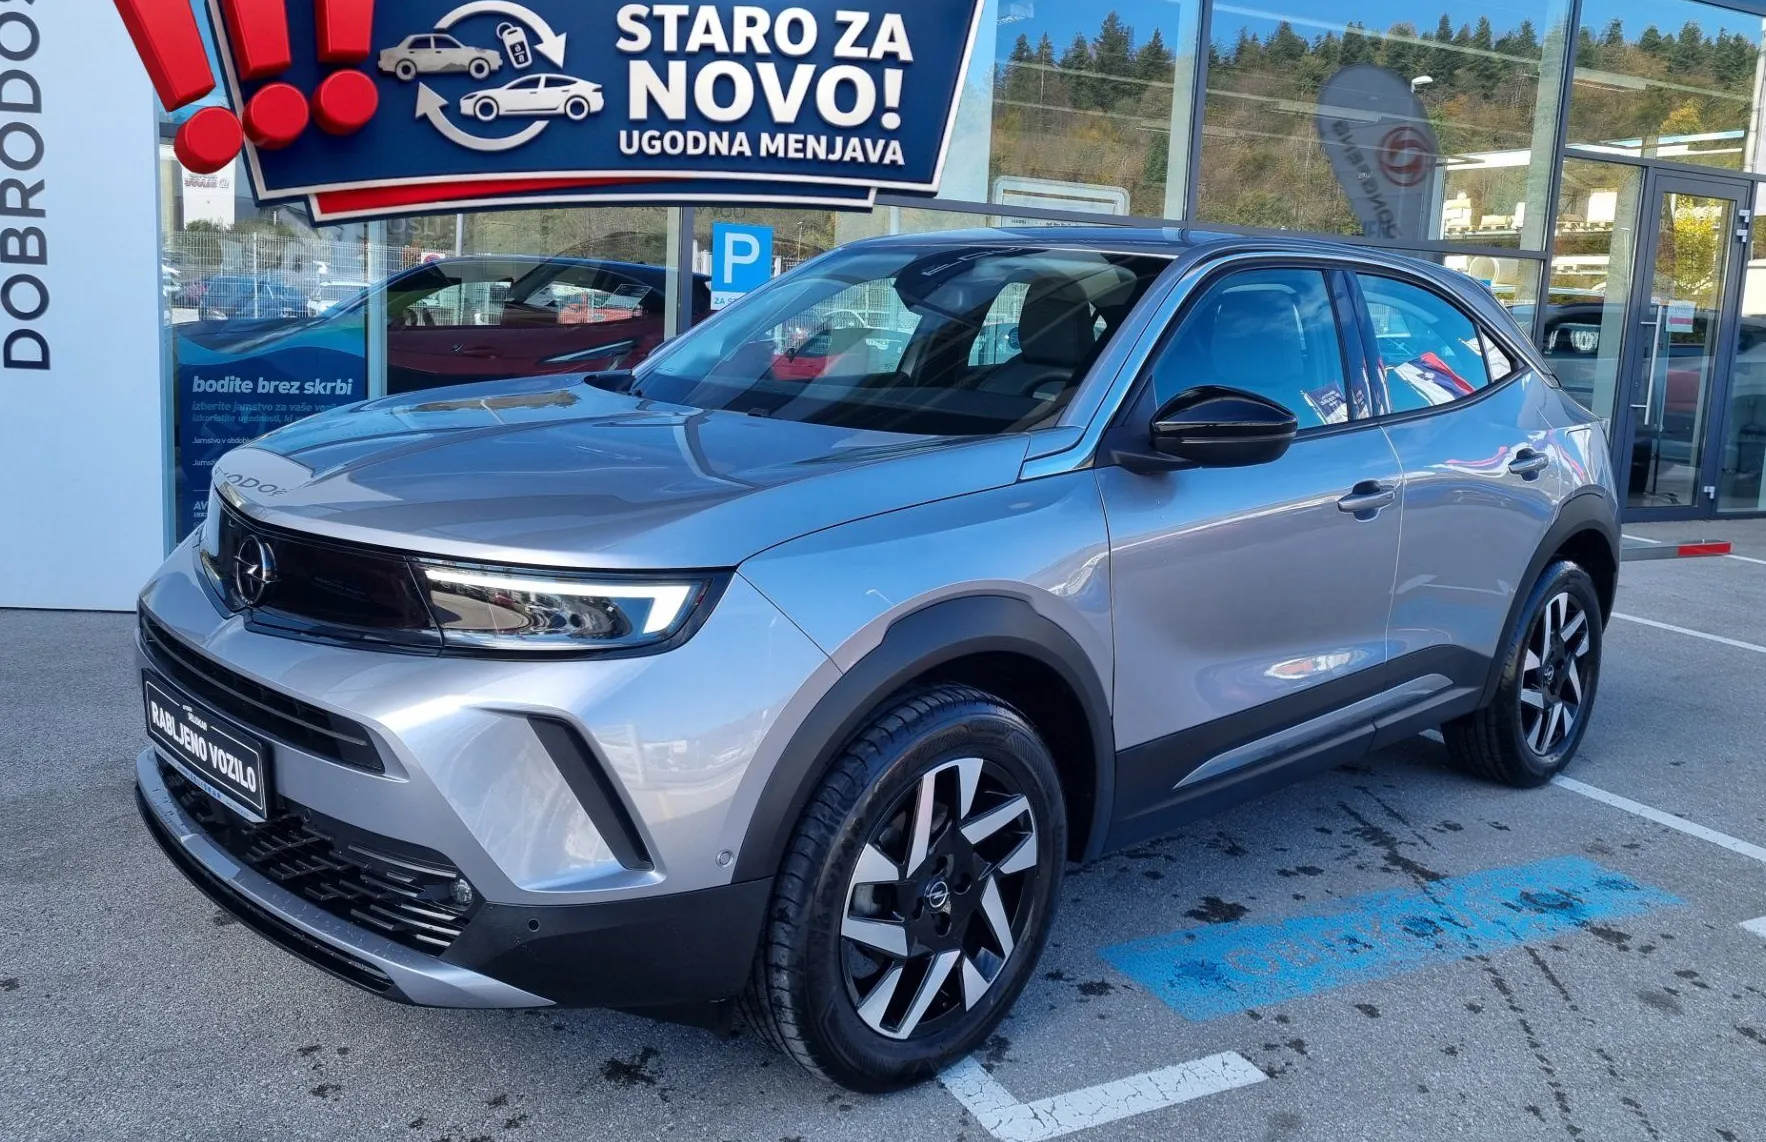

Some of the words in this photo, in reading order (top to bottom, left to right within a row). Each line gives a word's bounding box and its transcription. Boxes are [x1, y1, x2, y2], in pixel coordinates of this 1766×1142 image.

[0, 0, 50, 370] DOBRODO
[724, 232, 760, 284] P
[192, 375, 253, 393] bodite
[257, 377, 301, 394] brez
[303, 378, 353, 395] skrbi
[275, 403, 287, 412] za
[289, 402, 312, 412] vaše
[151, 700, 207, 762] RABLJENO
[208, 741, 257, 793] VOZILO
